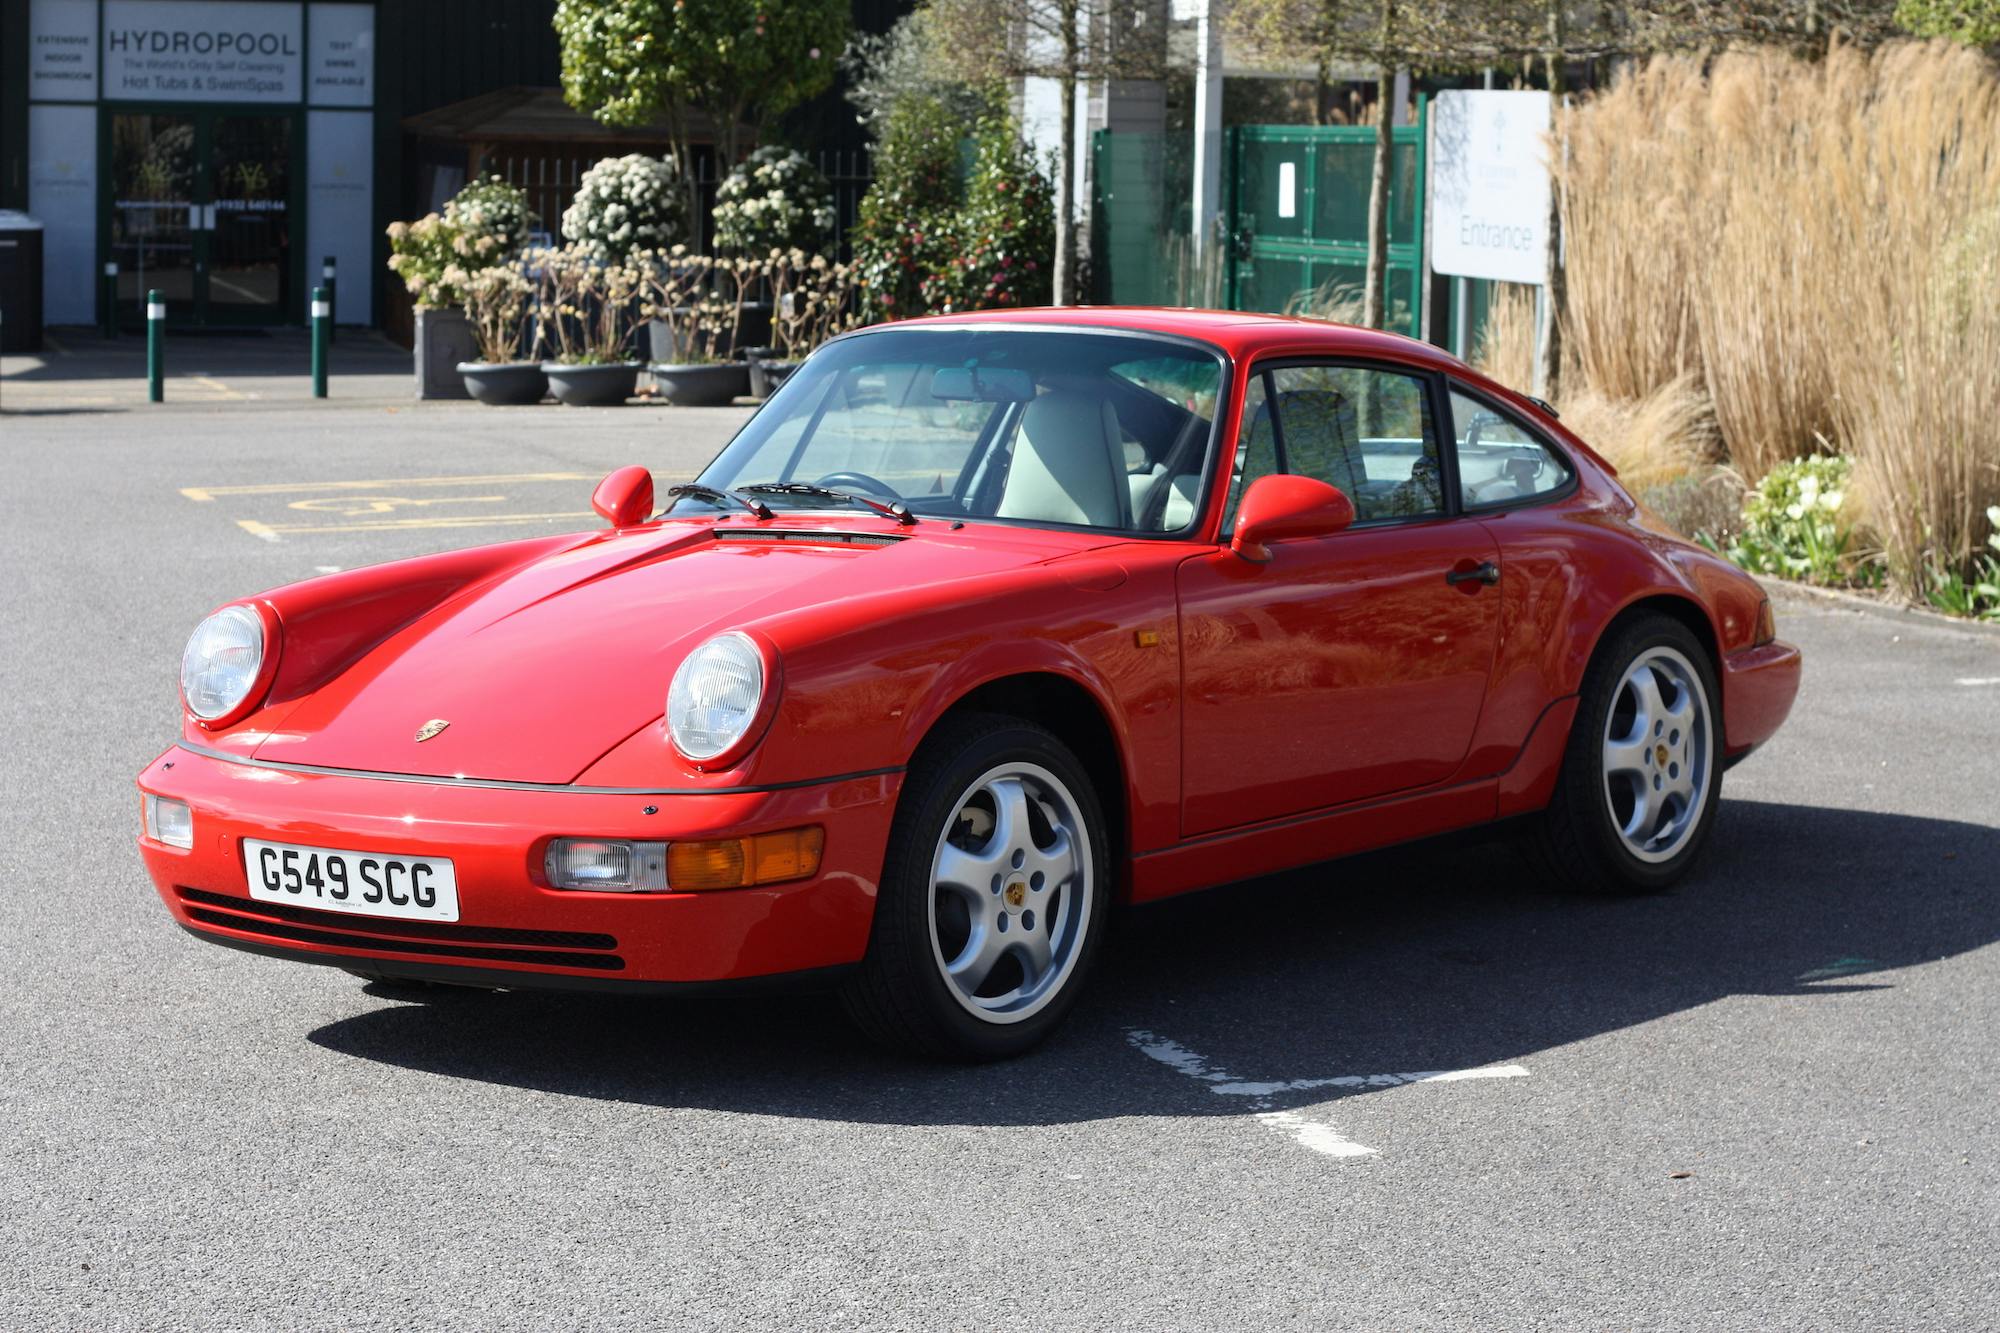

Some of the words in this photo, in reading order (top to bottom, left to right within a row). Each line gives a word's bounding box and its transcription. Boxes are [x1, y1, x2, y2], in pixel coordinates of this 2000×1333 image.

[110, 30, 296, 56] HYDROPOOL
[124, 58, 142, 69] The
[146, 59, 185, 70] World's
[188, 60, 212, 72] Only
[215, 60, 236, 72] Self
[238, 61, 285, 75] Cleaning
[122, 75, 149, 89] Hot
[154, 75, 188, 90] Tubs
[192, 77, 202, 90] &
[206, 77, 284, 93] SwimSpas
[1461, 214, 1533, 251] Entrance
[259, 847, 350, 901] G549
[359, 859, 436, 909] SCG
